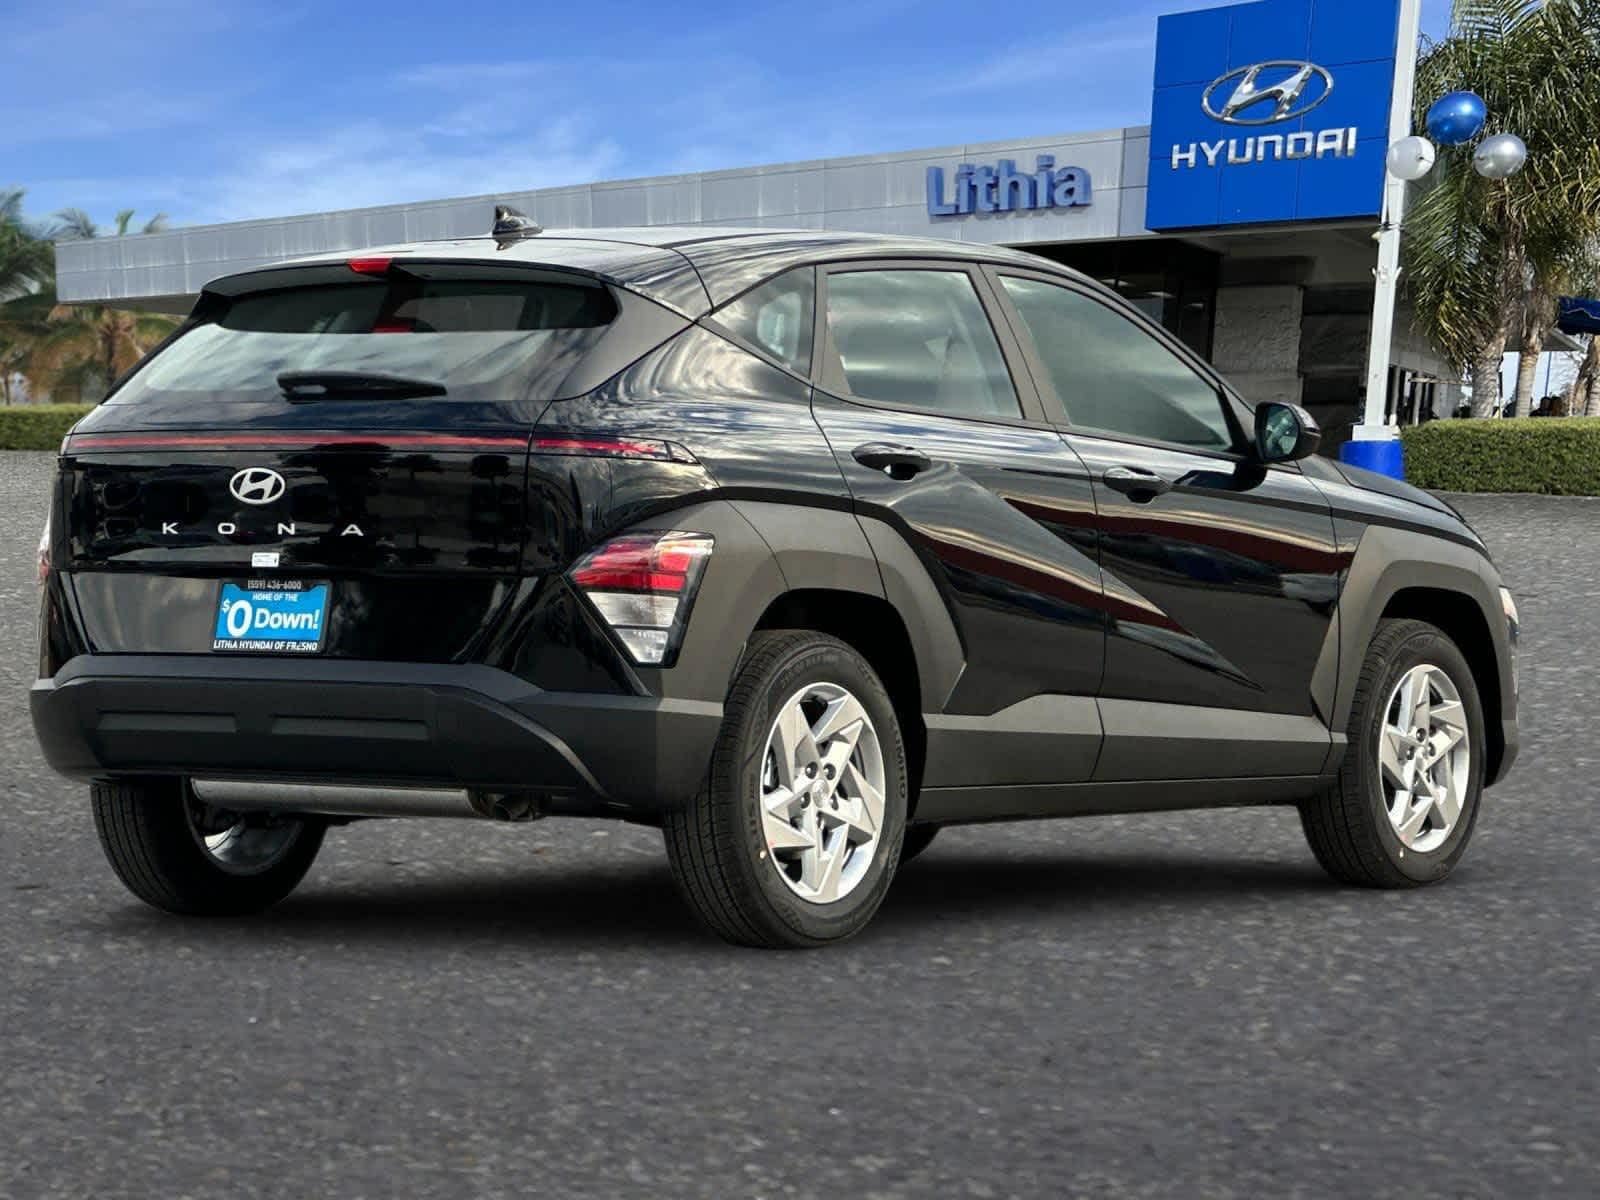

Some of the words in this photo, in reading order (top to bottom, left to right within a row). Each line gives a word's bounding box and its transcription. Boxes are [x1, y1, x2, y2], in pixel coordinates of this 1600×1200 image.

[1170, 126, 1359, 170] HYUNDAI
[926, 154, 1094, 217] Lithia
[161, 521, 365, 537] KONA
[252, 592, 273, 601] HOME
[273, 592, 284, 601] OF
[284, 592, 299, 602] THE
[254, 607, 321, 630] Down!
[238, 639, 273, 650] HYUNDAI
[274, 641, 286, 650] OF
